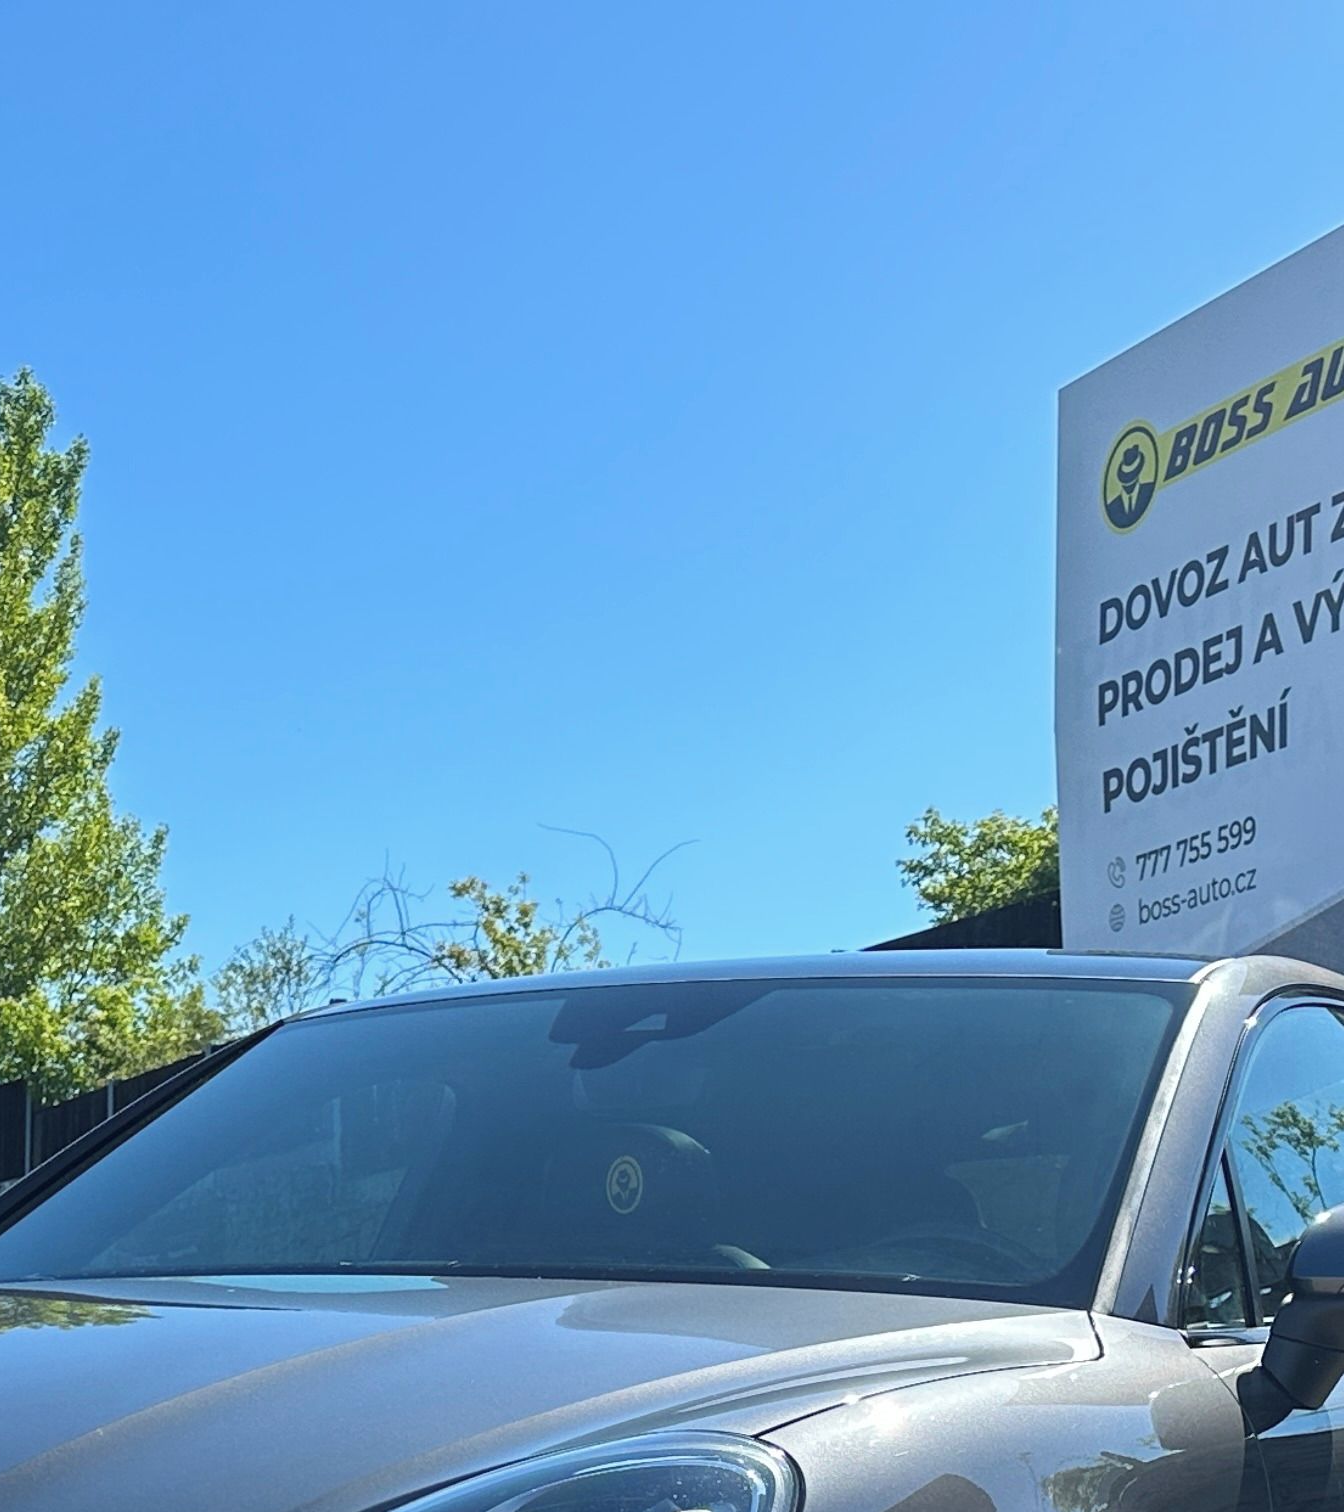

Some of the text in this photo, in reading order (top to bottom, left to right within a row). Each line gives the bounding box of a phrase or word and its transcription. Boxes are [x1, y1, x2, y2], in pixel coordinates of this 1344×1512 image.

[1163, 382, 1276, 481] BOSS
[1099, 545, 1230, 645] DOVOZ
[1238, 502, 1321, 582] AUT
[1098, 625, 1244, 727] PRODEJ
[1252, 613, 1284, 664] A
[1103, 686, 1292, 813] POJIŠTĚNÍ
[1136, 816, 1256, 882] 777 755 599
[1138, 868, 1257, 926] boss-auto.cz
